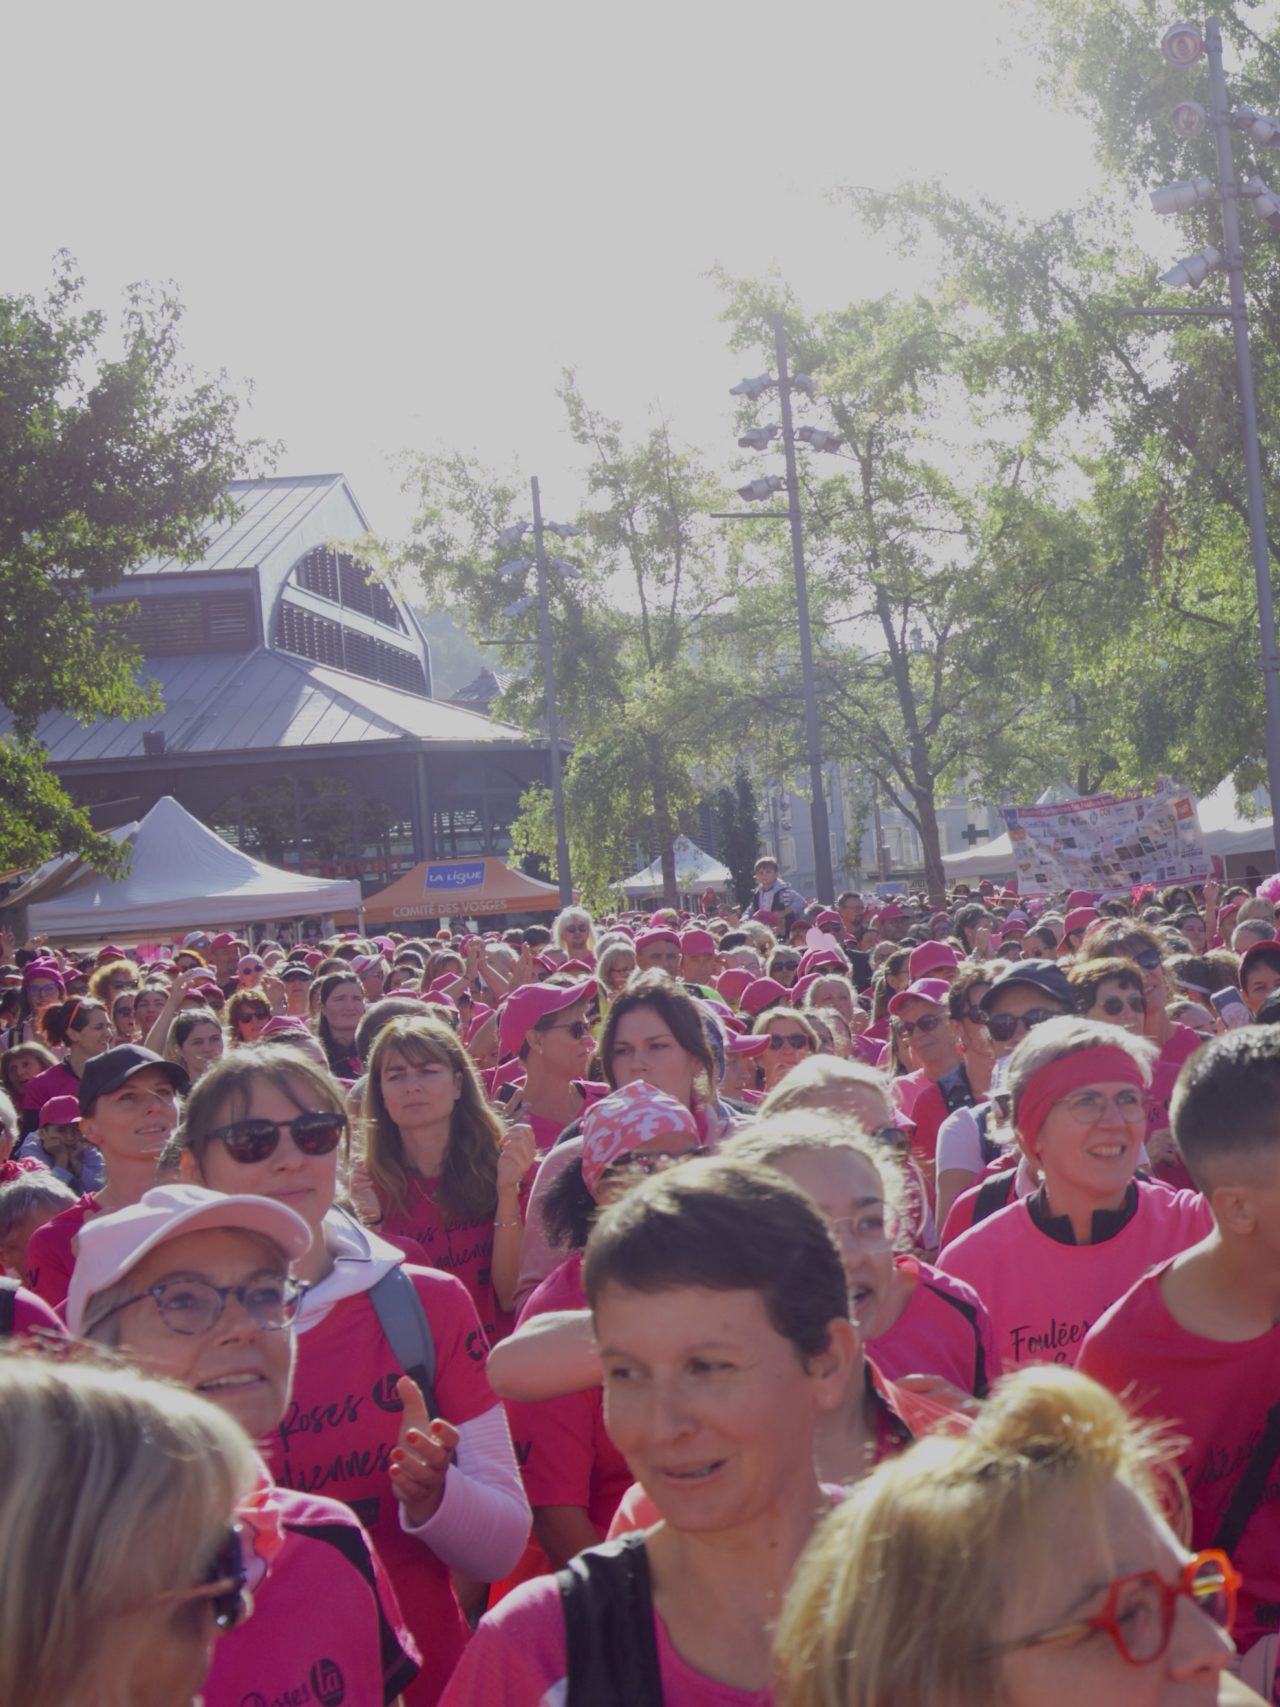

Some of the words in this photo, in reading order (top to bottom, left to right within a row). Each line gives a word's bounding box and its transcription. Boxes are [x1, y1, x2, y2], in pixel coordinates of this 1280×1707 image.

[428, 873, 446, 882] LA
[437, 901, 458, 915] DES
[462, 900, 508, 913] VOSGES
[279, 1394, 364, 1452] Roses
